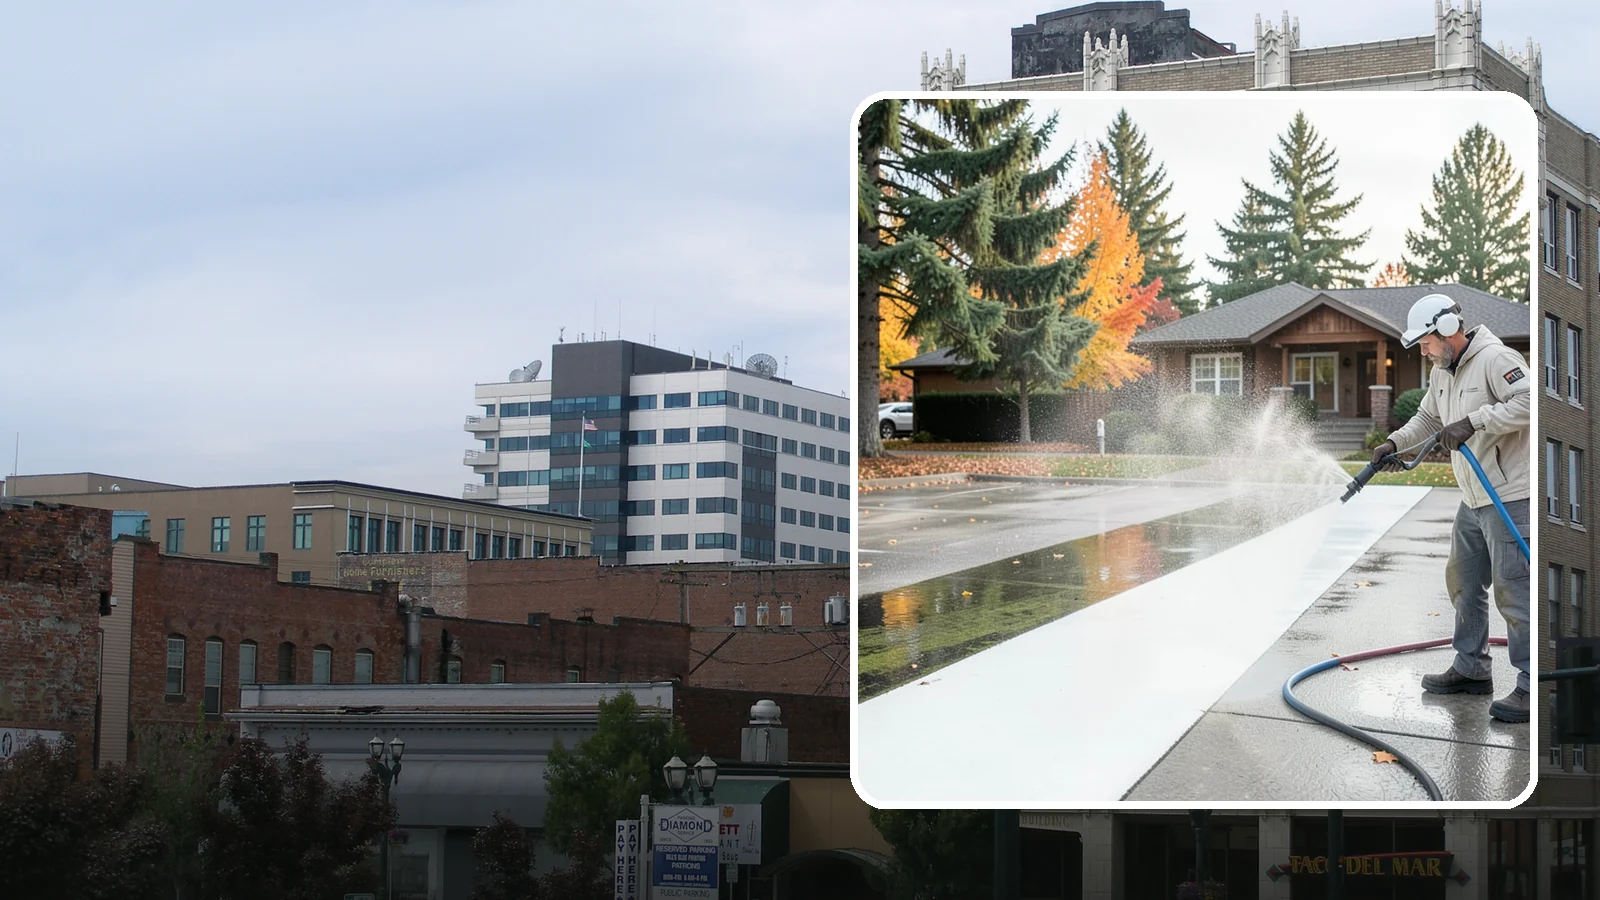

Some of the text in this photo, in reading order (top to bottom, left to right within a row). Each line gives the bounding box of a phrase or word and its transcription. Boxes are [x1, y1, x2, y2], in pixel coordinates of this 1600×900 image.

[370, 566, 427, 576] Furnishers
[660, 818, 713, 833] DIAMOND
[1022, 815, 1070, 828] BUILDING
[617, 825, 625, 852] PAY
[628, 824, 636, 852] PAY
[656, 845, 716, 854] RESERVED PARKING
[721, 851, 739, 862] Soup
[627, 855, 636, 893] HERE
[1346, 856, 1385, 876] DEL
[1392, 857, 1442, 877] MAR
[616, 856, 624, 894] HERE
[660, 888, 710, 898] PUBLIC PARKING
